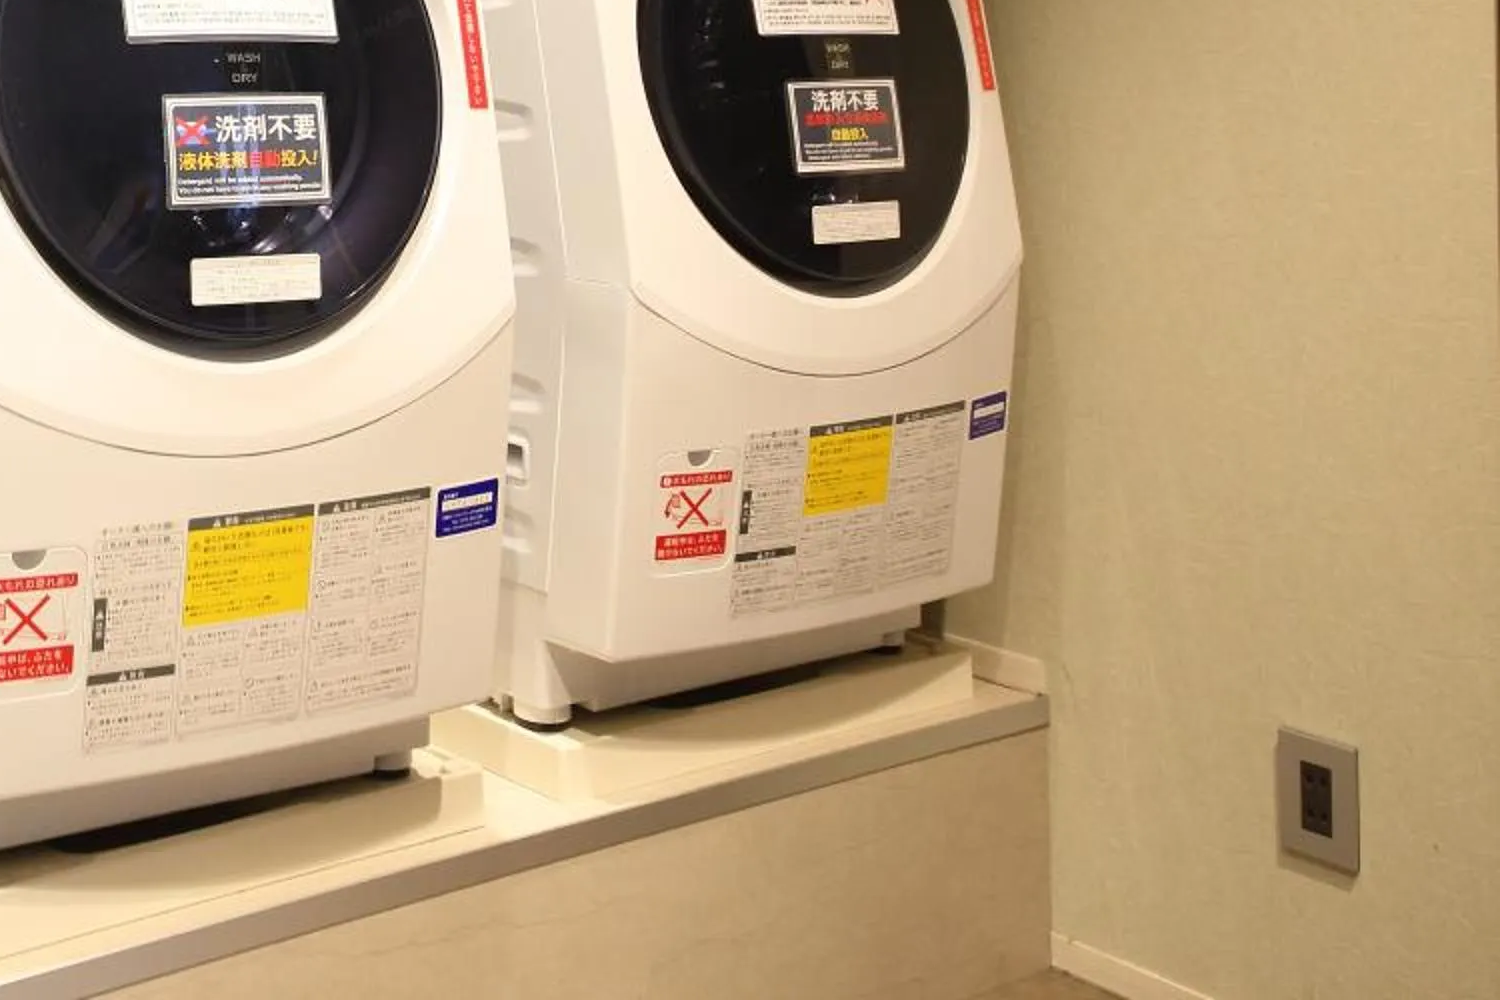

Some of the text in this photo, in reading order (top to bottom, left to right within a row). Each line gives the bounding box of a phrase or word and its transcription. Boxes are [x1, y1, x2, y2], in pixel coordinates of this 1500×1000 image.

[227, 53, 261, 63] WASH
[231, 73, 259, 83] DRY
[811, 89, 880, 112] 洗剤不要
[215, 114, 317, 143] 洗剤不要
